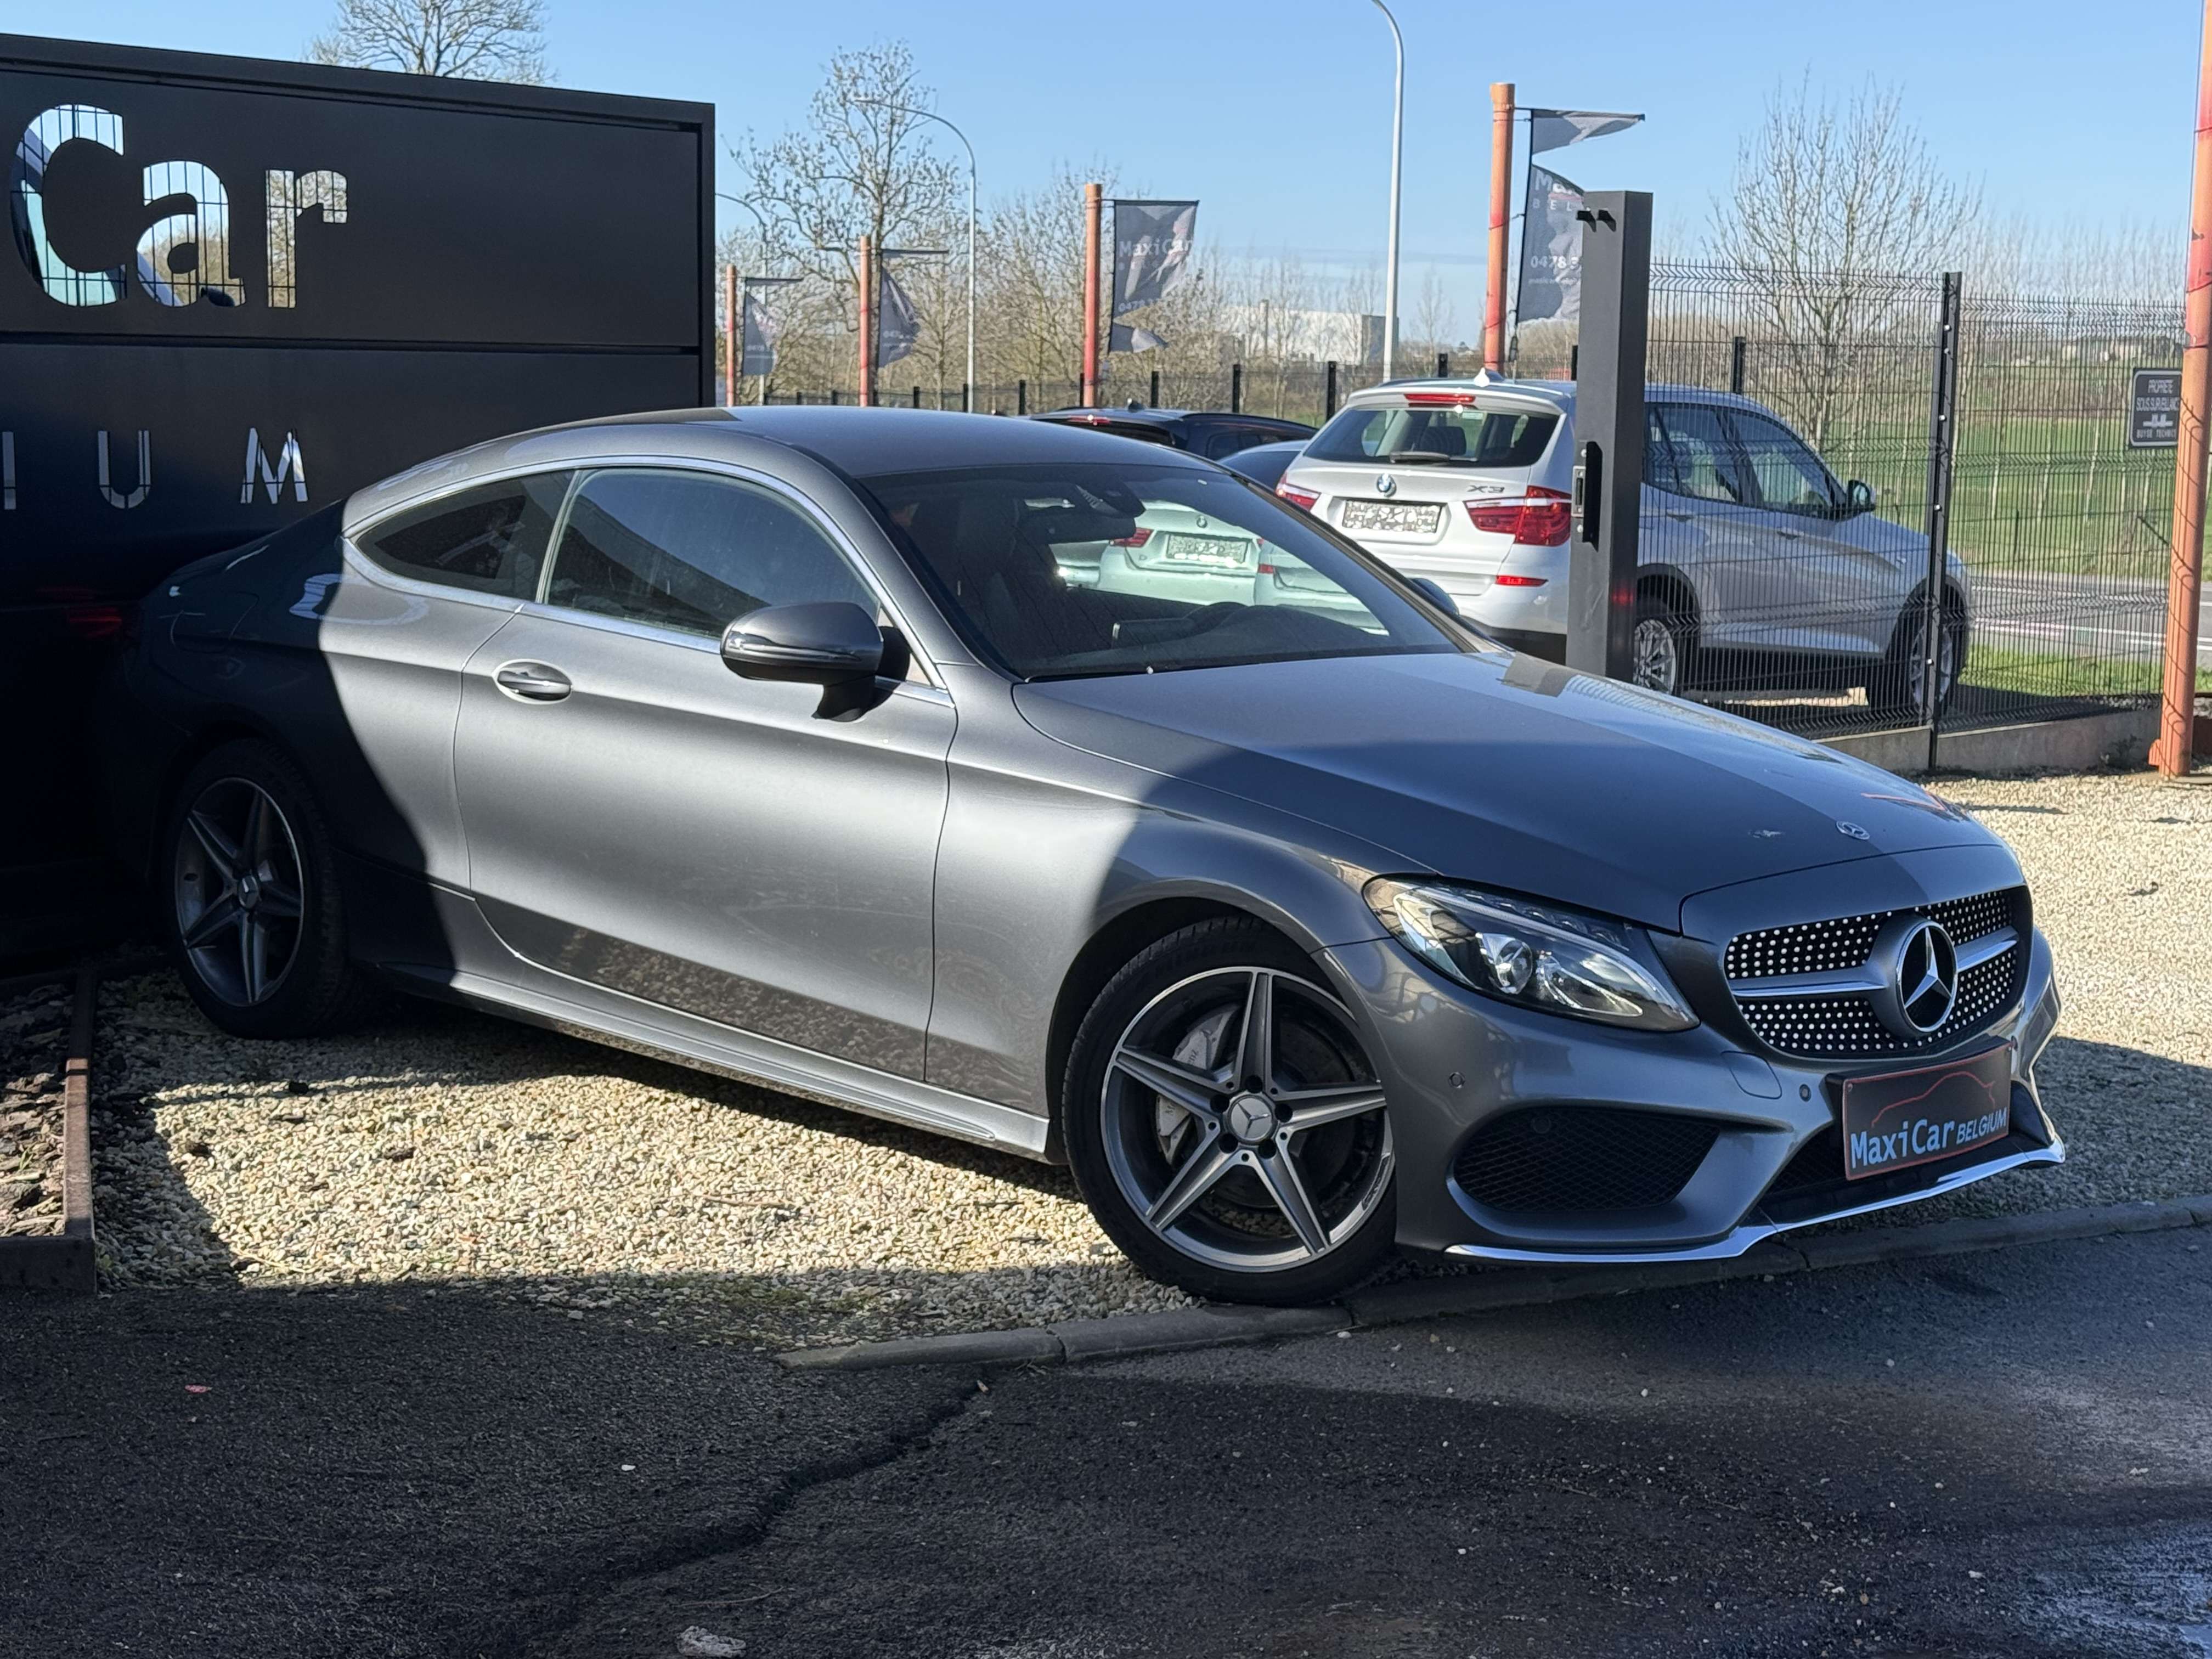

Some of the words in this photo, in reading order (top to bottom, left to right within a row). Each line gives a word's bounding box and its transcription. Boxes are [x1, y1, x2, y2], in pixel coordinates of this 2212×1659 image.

[10, 104, 348, 308] Car
[1467, 484, 1505, 494] X3
[1850, 1118, 1954, 1169] MaxiCar
[1956, 1107, 2007, 1146] BELGIUM
